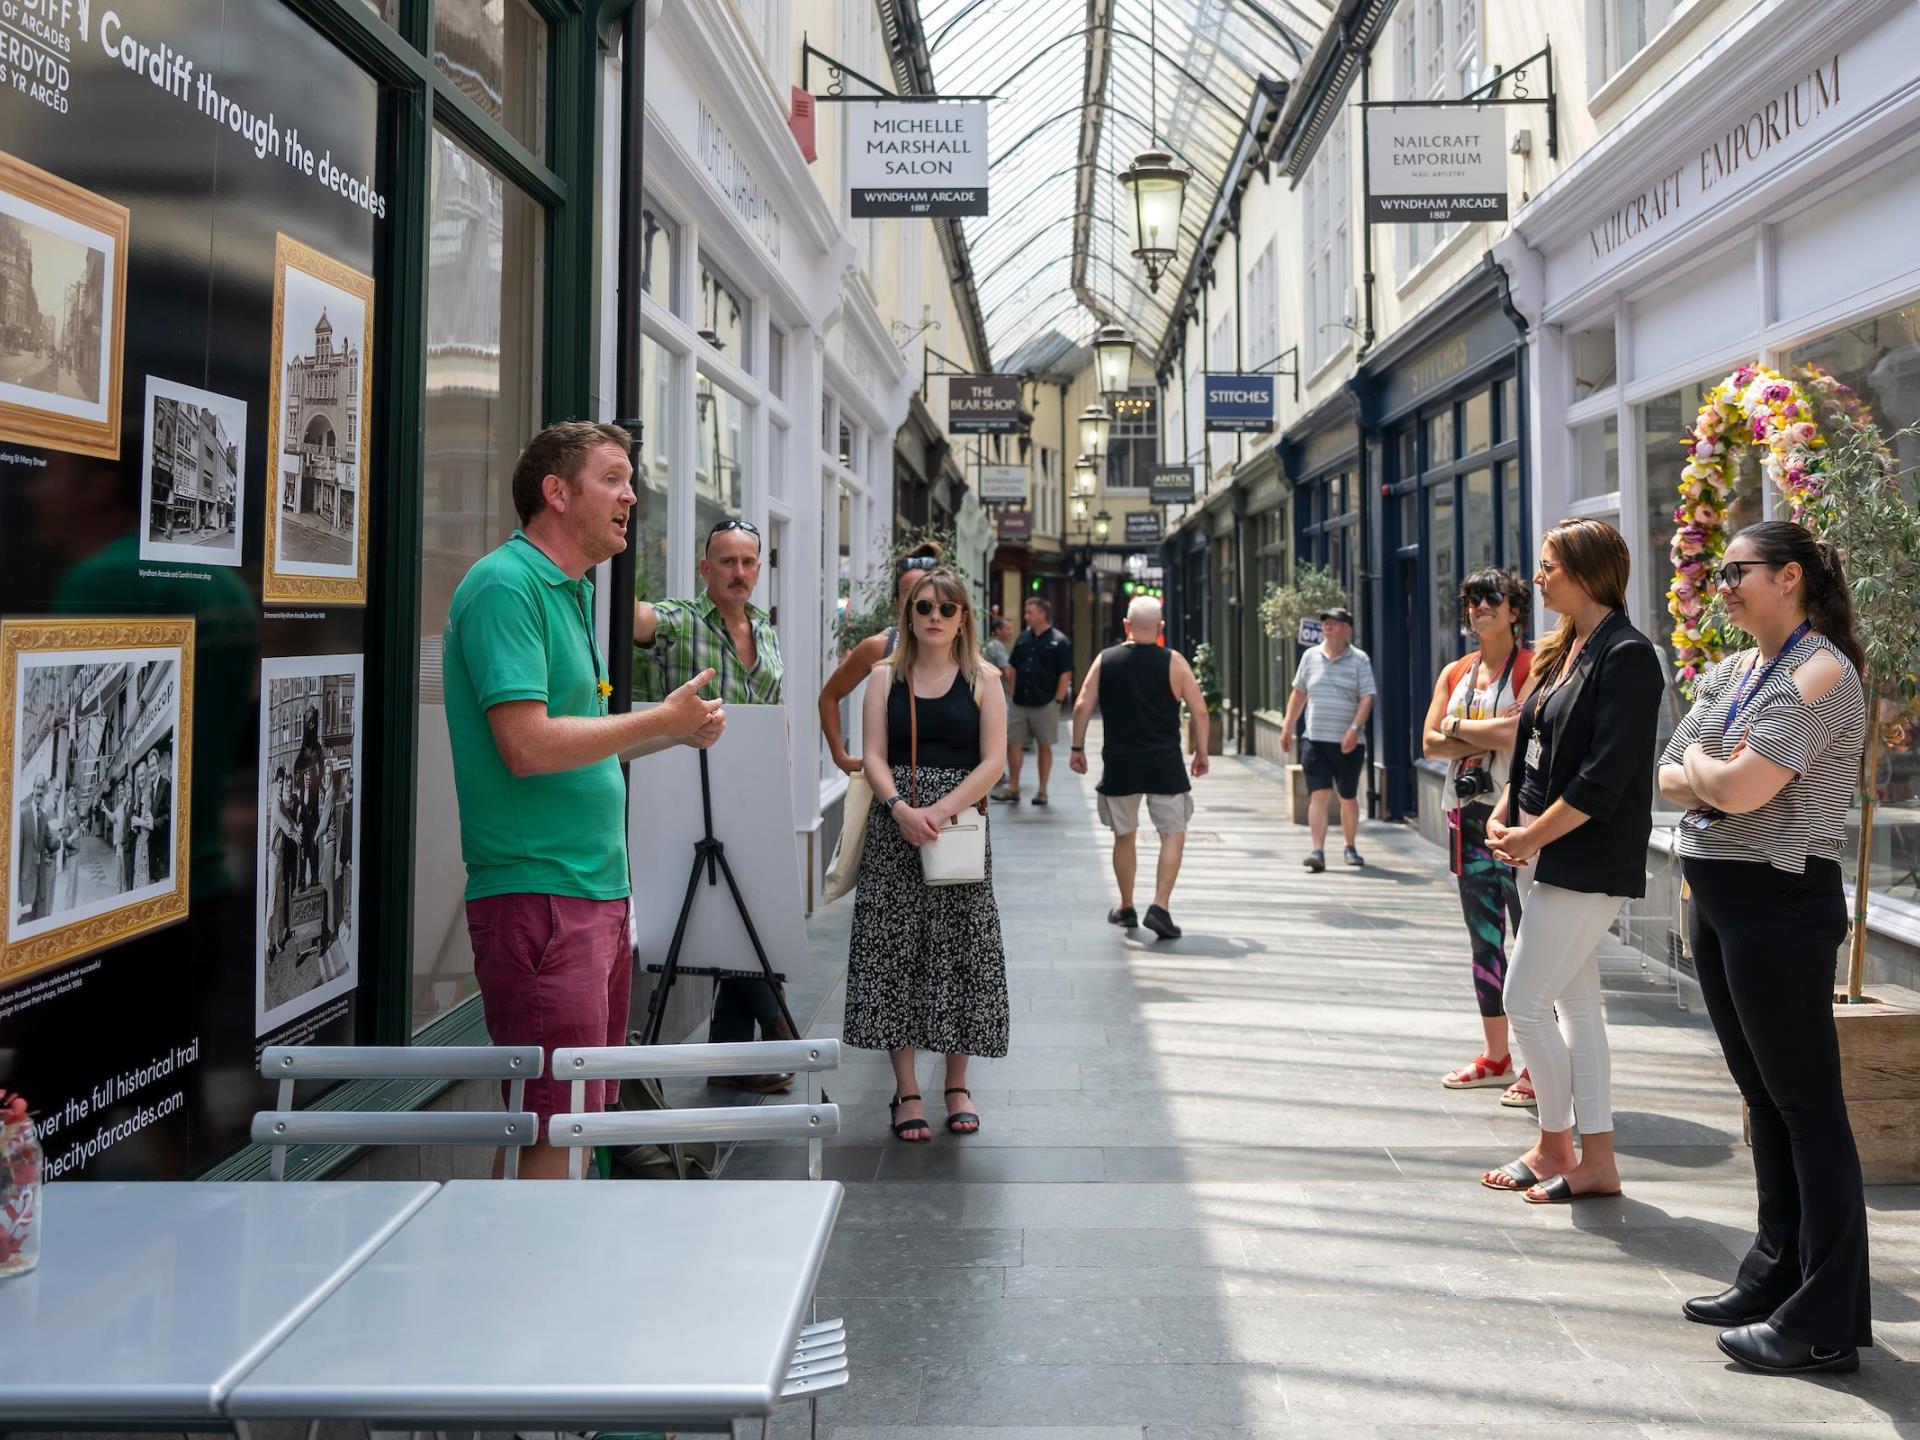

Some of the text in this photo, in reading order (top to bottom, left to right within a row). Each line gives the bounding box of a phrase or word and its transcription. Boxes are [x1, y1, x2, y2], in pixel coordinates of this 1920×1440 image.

[3, 0, 71, 52] OF ARCADES
[11, 69, 26, 93] YR
[30, 82, 68, 114] ARCÊD
[101, 11, 386, 219] Cardiff through the decades
[874, 119, 965, 133] MICHELLE
[867, 140, 972, 154] MARSHALL
[1393, 135, 1481, 148] NAILCRAFT
[1393, 152, 1482, 166] EMPORIUM
[1590, 54, 1841, 264] NAILCRAFT EMPORIUM
[885, 160, 952, 175] SALON
[864, 191, 976, 202] WYNDHAM ARCADE
[910, 204, 931, 212] 1887
[1380, 198, 1499, 210] WYNDHAM ARCADE
[1429, 211, 1451, 220] 1887
[971, 386, 994, 398] THE
[1209, 390, 1270, 404] STITCHES
[950, 399, 1016, 411] BEAR SHOP
[1154, 474, 1191, 483] ANTICS
[65, 1098, 89, 1126] the
[92, 1078, 113, 1113] full
[117, 1048, 174, 1099] historical
[177, 1036, 199, 1068] trail
[42, 1091, 184, 1184] hecityofarcades.com
